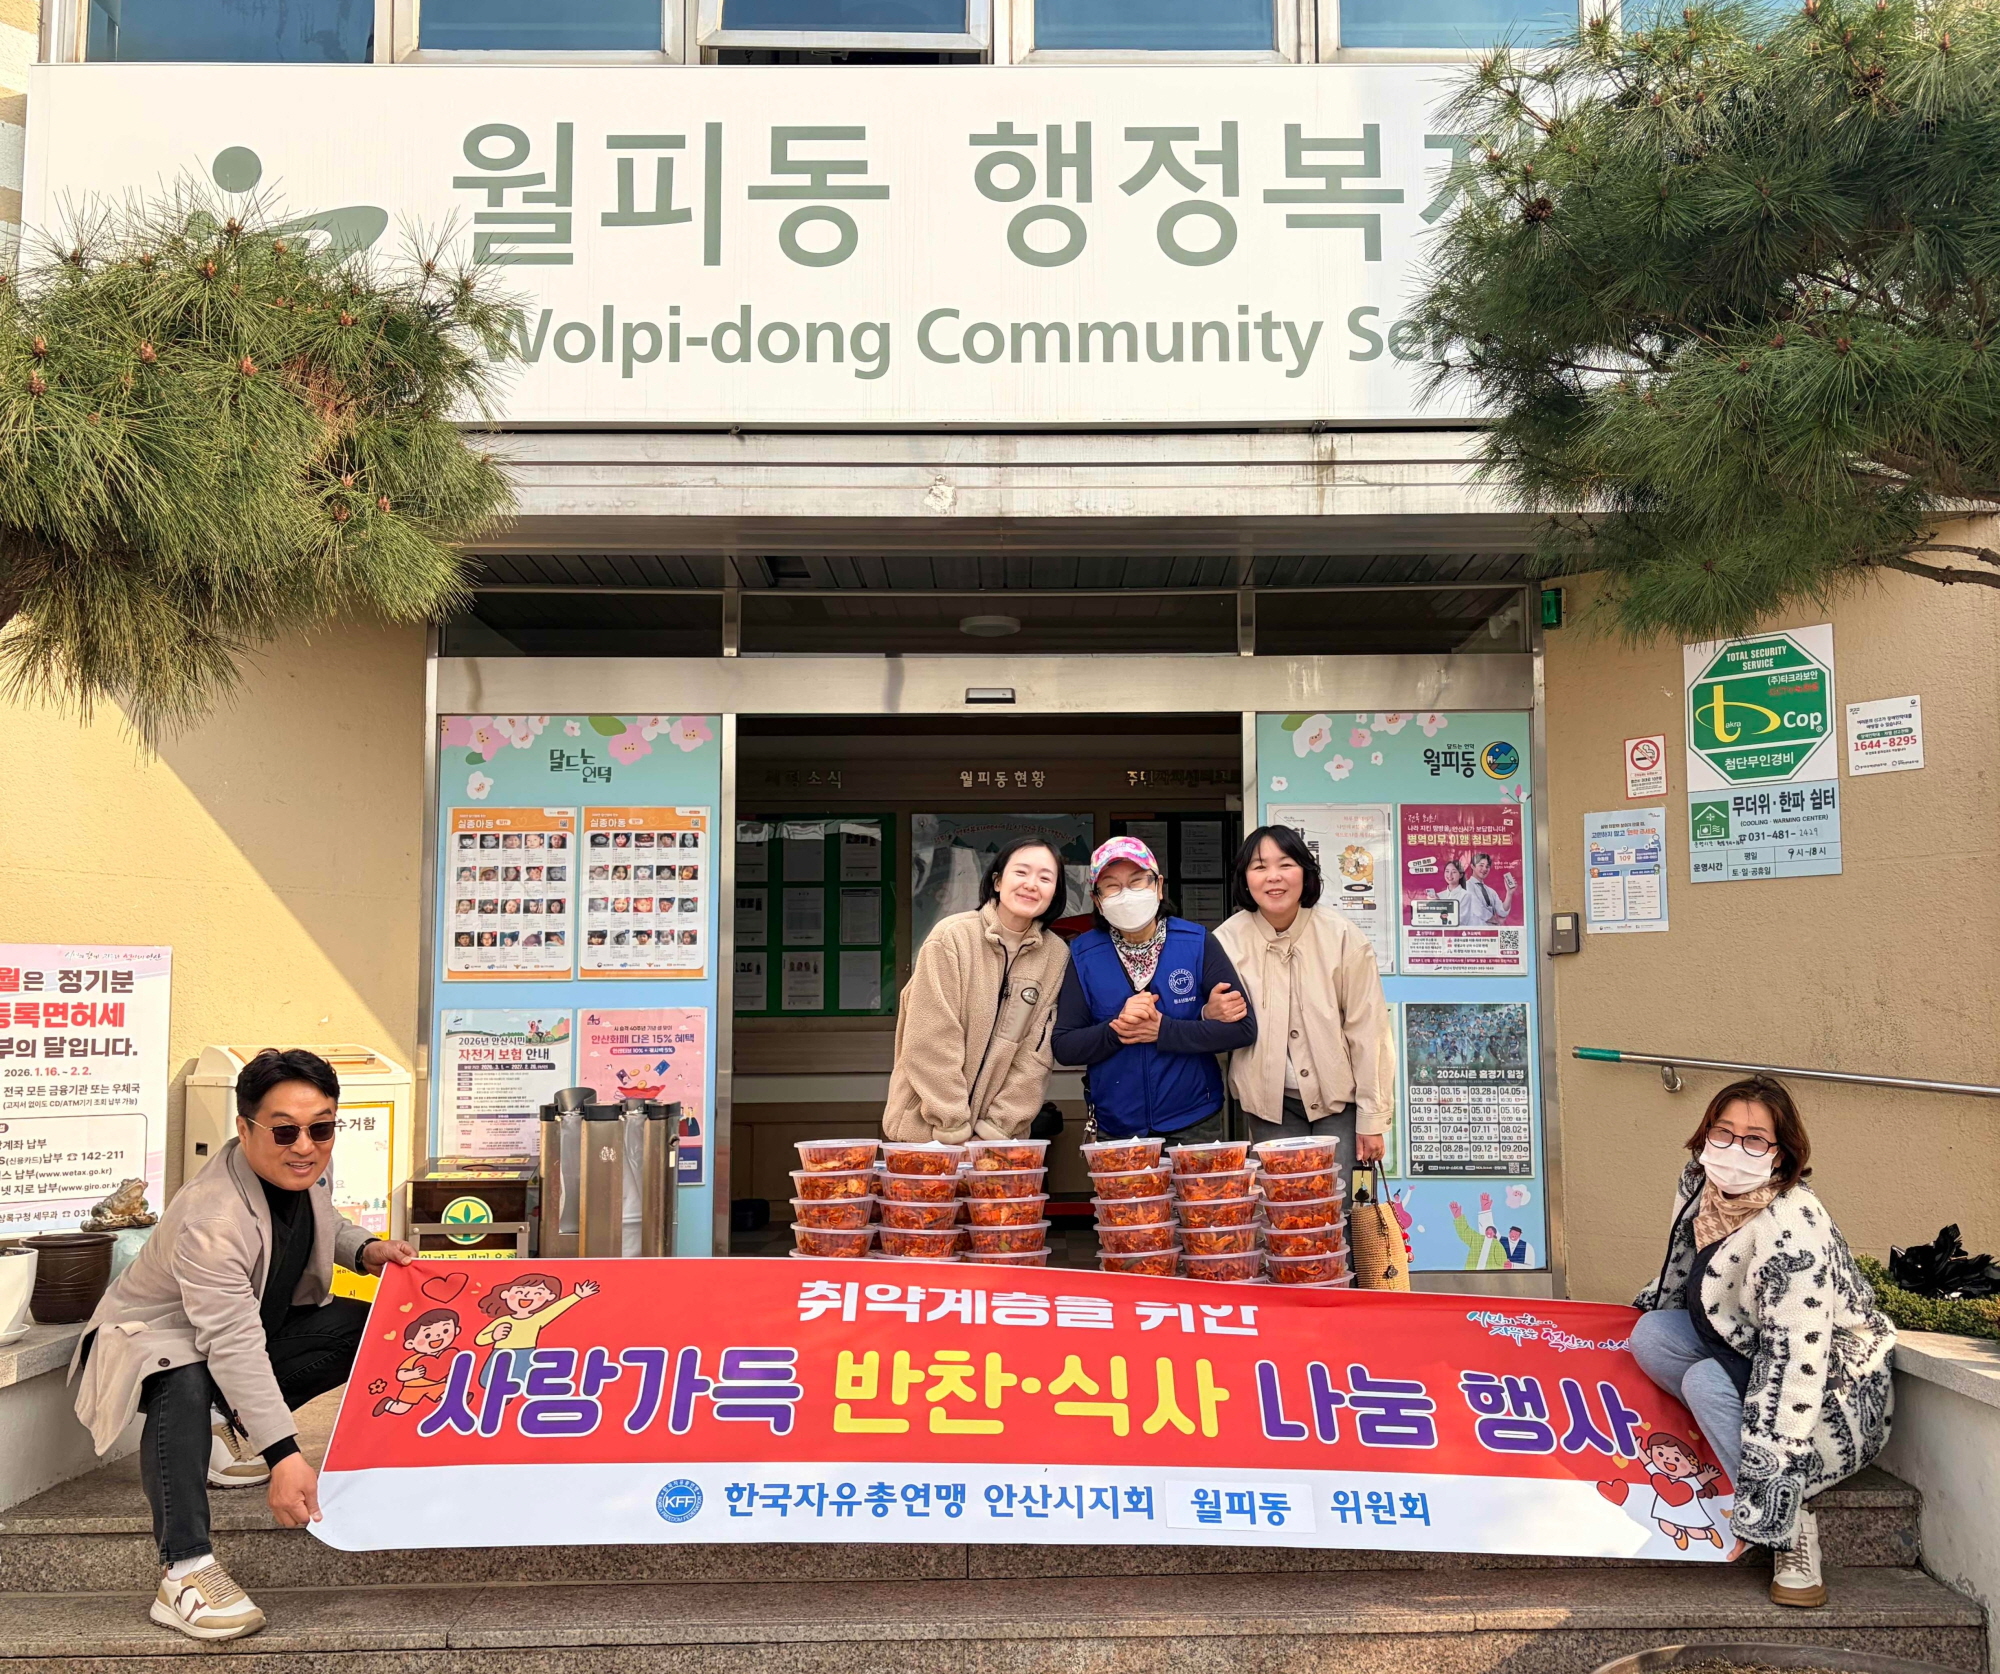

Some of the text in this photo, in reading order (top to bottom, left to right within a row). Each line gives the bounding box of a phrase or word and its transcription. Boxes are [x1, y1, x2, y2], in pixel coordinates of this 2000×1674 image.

[453, 121, 890, 267] 월피동
[490, 305, 890, 380] Wolpi-dong
[917, 305, 1323, 378] Community
[1726, 645, 1787, 662] TOTAL SECURITY
[1742, 658, 1774, 670] SERVICE
[1767, 670, 1818, 686] (주)타크라보안
[1783, 711, 1822, 730] Cop
[1854, 735, 1917, 751] 1644-8295
[550, 748, 596, 771] 달드는
[1423, 748, 1477, 778] 월피동
[1724, 751, 1795, 771] 첨단무인경비
[582, 766, 612, 783] 언덕
[1809, 787, 1836, 810] 쉼터
[458, 819, 494, 829] 실종아동
[590, 818, 626, 828] 실종아동
[1740, 813, 1829, 828] (COOLING WARMING CENTER)
[1407, 833, 1513, 846] 병역의무 이행 청년카드
[1591, 830, 1613, 838] 고민하지
[1693, 852, 1757, 872] 운영시간 평일
[1732, 866, 1772, 877] 토·일·공휴일
[0, 967, 134, 993] 월은 정기분
[1174, 977, 1189, 987] KFF
[458, 1036, 526, 1046] 2026년 안산시민
[591, 1033, 695, 1044] 안산화폐 다온 15% 혜택
[43, 1036, 138, 1058] 달입니다.
[458, 1048, 550, 1061] 자전거 보험 안내
[4, 1068, 33, 1077] 2026.
[35, 1067, 43, 1077] 1.
[44, 1067, 60, 1076] 16.
[70, 1066, 80, 1076] 2.
[82, 1066, 92, 1075] 2.
[1436, 1069, 1524, 1079] 2026시즌 홈경기 일정
[3, 1083, 141, 1097] 전국 모든 금융기관 또는 우체국
[1411, 1087, 1432, 1095] 03.08
[1440, 1087, 1460, 1095] 03.15
[1470, 1087, 1492, 1095] 03.28
[1499, 1087, 1521, 1095] 04.05
[3, 1097, 138, 1109] (고지서 없이도 CD/ATM기기 조회 납부 가능)
[1411, 1106, 1432, 1114] 04.19
[1441, 1106, 1463, 1114] 04.25
[1471, 1106, 1491, 1114] 05.10
[1500, 1106, 1520, 1114] 05.16
[334, 1116, 376, 1132] 수거함
[1412, 1125, 1432, 1133] 05.31
[1441, 1125, 1463, 1133] 07.04
[1471, 1125, 1490, 1133] 07.11
[1500, 1125, 1522, 1133] 08.02
[0, 1138, 47, 1150] 계좌 납부
[1412, 1144, 1434, 1152] 08.22
[1442, 1144, 1464, 1152] 08.28
[1472, 1144, 1492, 1152] 09.12
[1501, 1144, 1523, 1152] 09.20
[81, 1150, 124, 1161] 142-211
[14, 1167, 112, 1180] 납부(www.wetax.go.kr)
[14, 1185, 35, 1194] 지로
[33, 1211, 58, 1221] 세무과
[797, 1280, 1115, 1330] 취약계층을
[418, 1346, 1643, 1460] 사랑가득 반찬·식사 나눔 행사
[664, 1496, 697, 1508] KFF
[724, 1480, 1431, 1527] 한국자유총연맹 안산시지회 월피동 위원회
